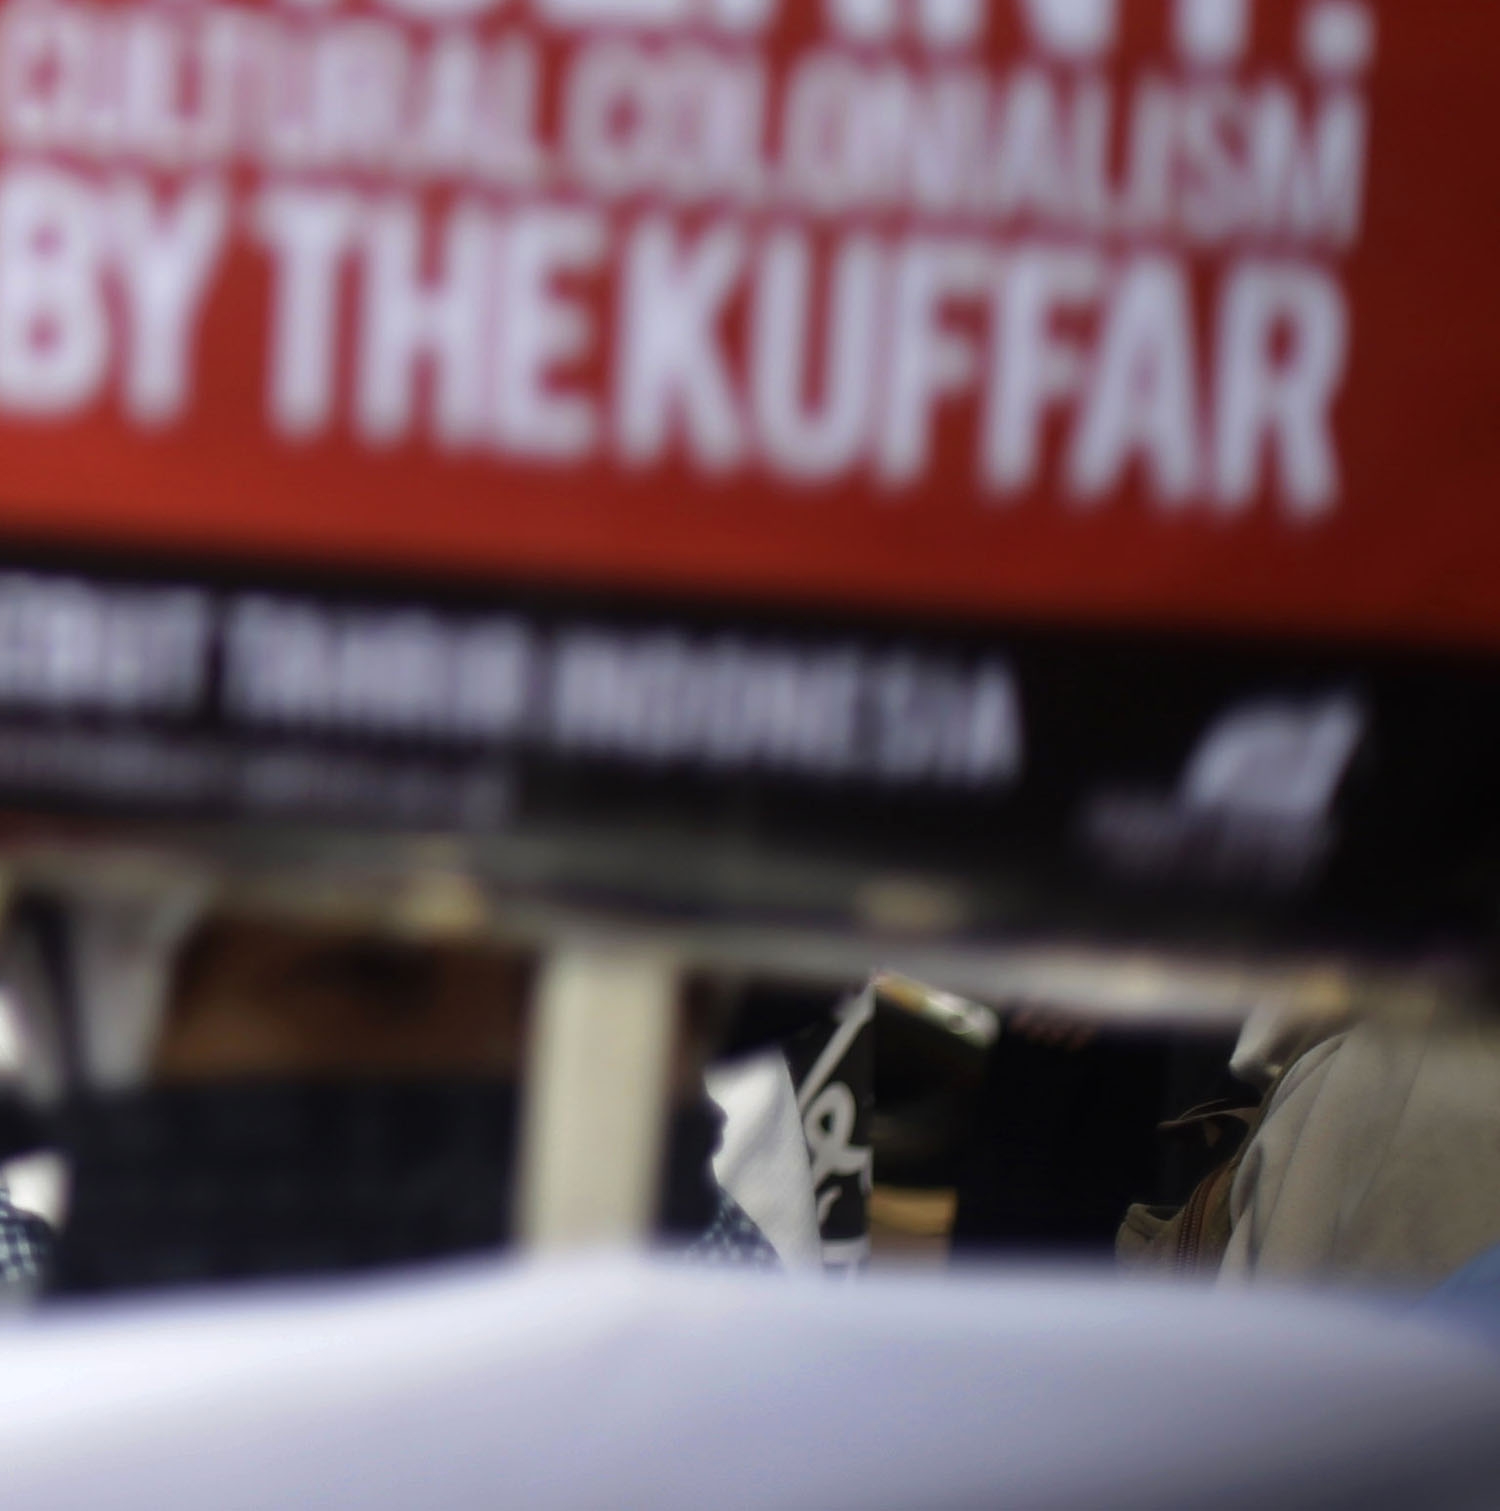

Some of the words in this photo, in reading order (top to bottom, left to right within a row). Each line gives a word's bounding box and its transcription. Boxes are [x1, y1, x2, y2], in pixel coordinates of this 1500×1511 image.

[562, 28, 1371, 250] COLONIALISM
[254, 180, 608, 462] THE
[616, 206, 1346, 520] KUFFAR
